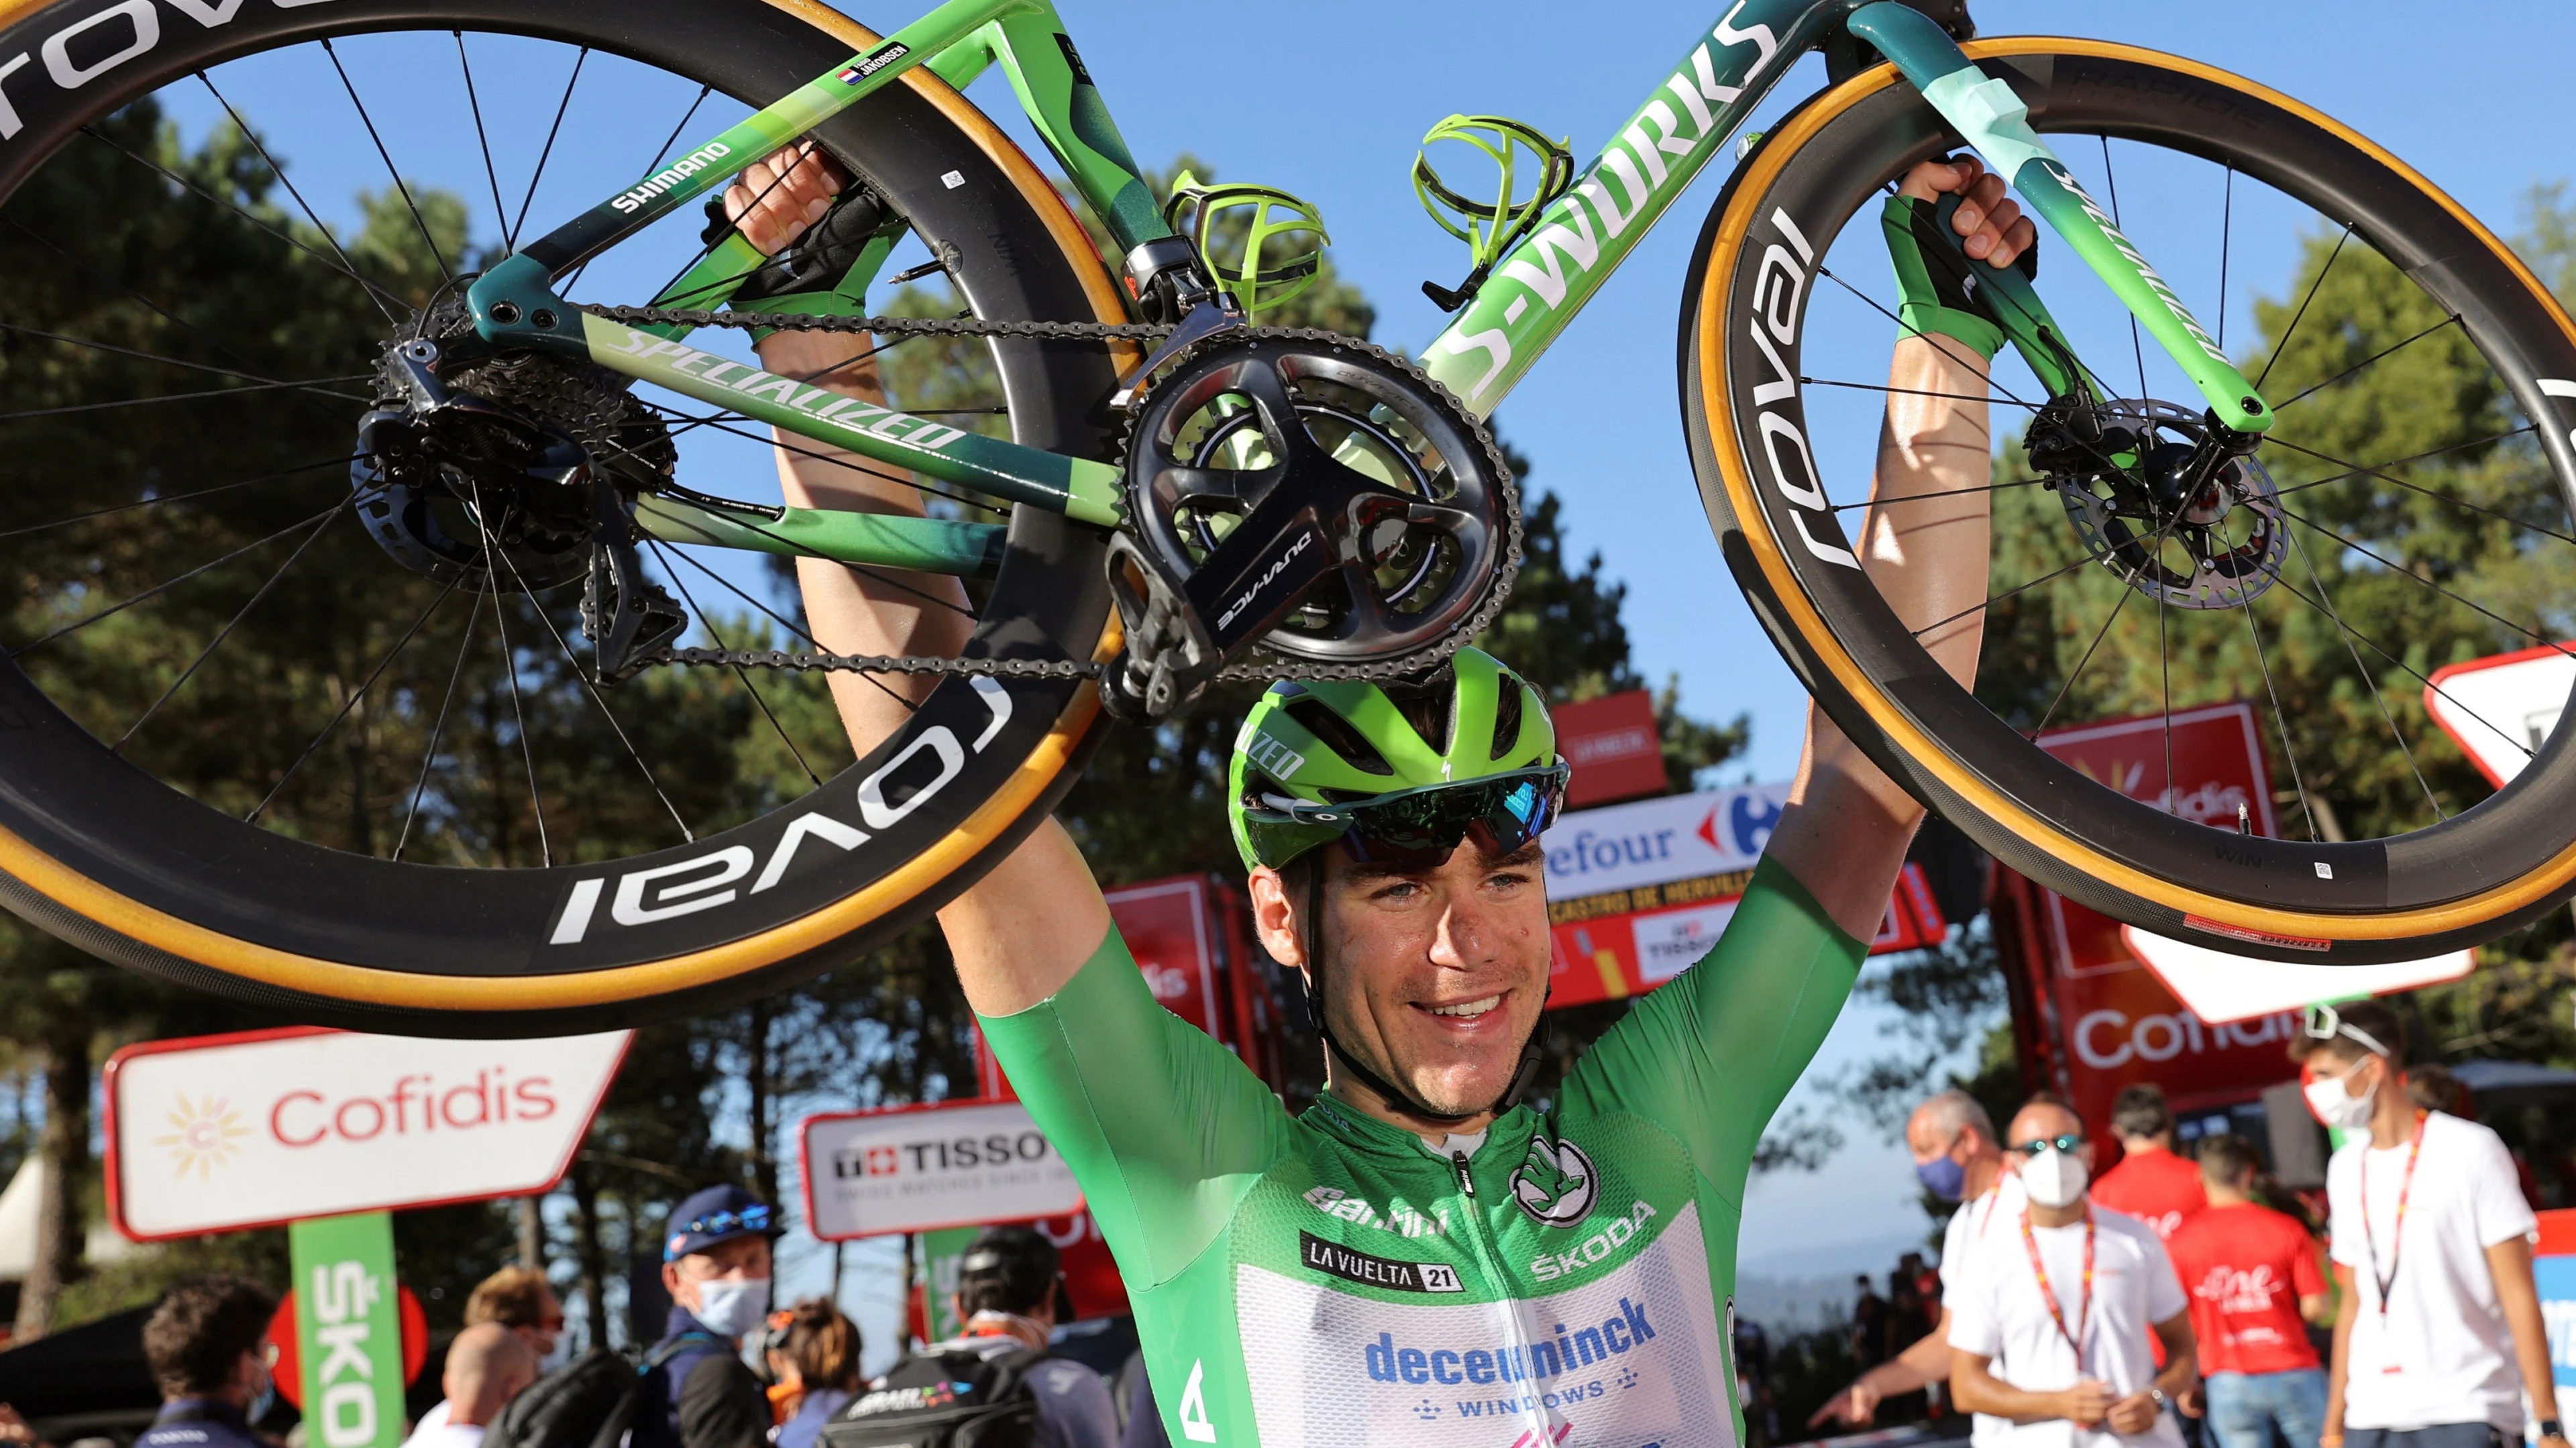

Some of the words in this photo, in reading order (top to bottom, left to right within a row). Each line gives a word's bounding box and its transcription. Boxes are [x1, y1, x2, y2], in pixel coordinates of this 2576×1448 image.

[853, 58, 871, 69] FABIO
[859, 45, 908, 76] JAKOBSEN
[611, 142, 731, 215] SHIMANO
[1442, 0, 1778, 401] S-WORKS
[606, 331, 967, 449] SPECIALIZED
[1217, 531, 1312, 631] DURA-ACE
[1543, 826, 1675, 877] efour
[269, 1066, 557, 1149] Cofidis
[903, 1130, 1055, 1173] TISSO
[1310, 1241, 1333, 1268] LA
[1338, 1250, 1412, 1286] VUELTA
[1428, 1269, 1452, 1287] 21
[1530, 1199, 1657, 1282] ŠKODA
[311, 1260, 381, 1448] ŠKO
[1364, 1296, 1657, 1386] deceuninck
[1456, 1380, 1605, 1418] WINDOWS
